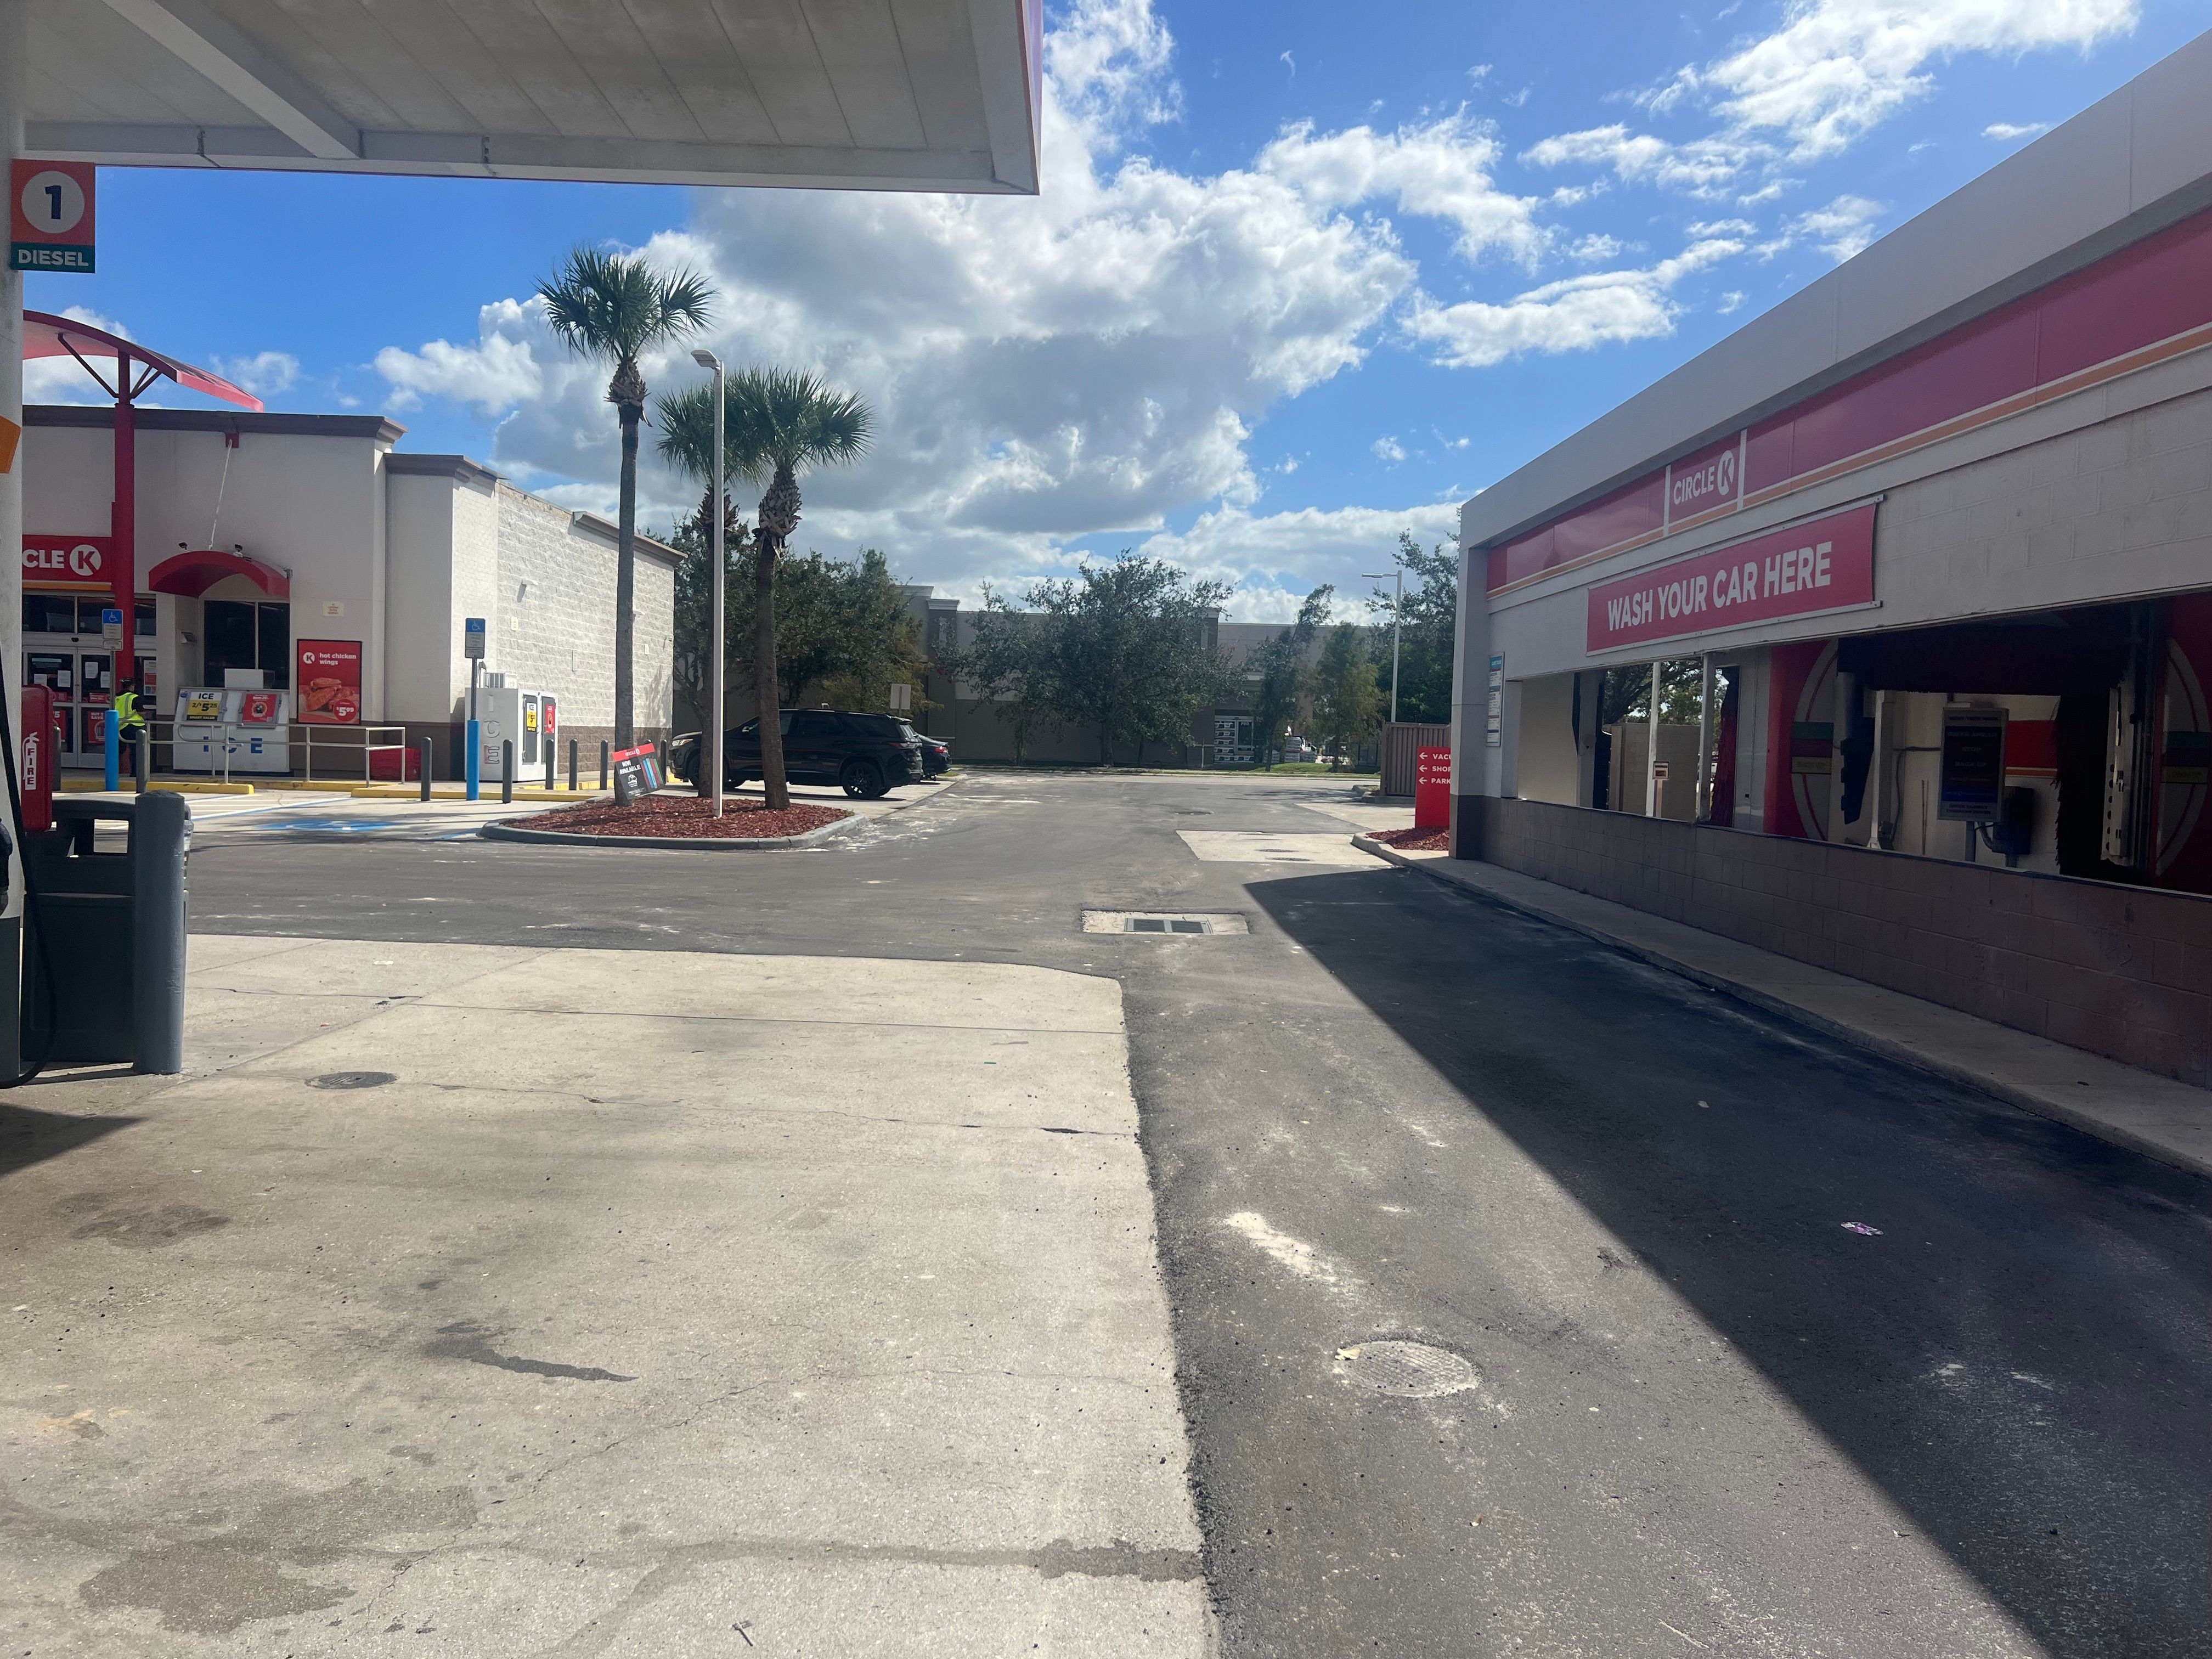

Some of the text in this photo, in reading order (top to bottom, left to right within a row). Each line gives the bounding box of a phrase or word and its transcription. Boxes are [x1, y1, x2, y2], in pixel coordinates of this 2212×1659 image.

[45, 185, 61, 219] 1
[18, 249, 89, 267] DIESEL
[1673, 454, 1734, 505] CIRCLE K
[74, 548, 100, 575] K
[1608, 541, 1832, 631] WASH YOUR CAR HERE
